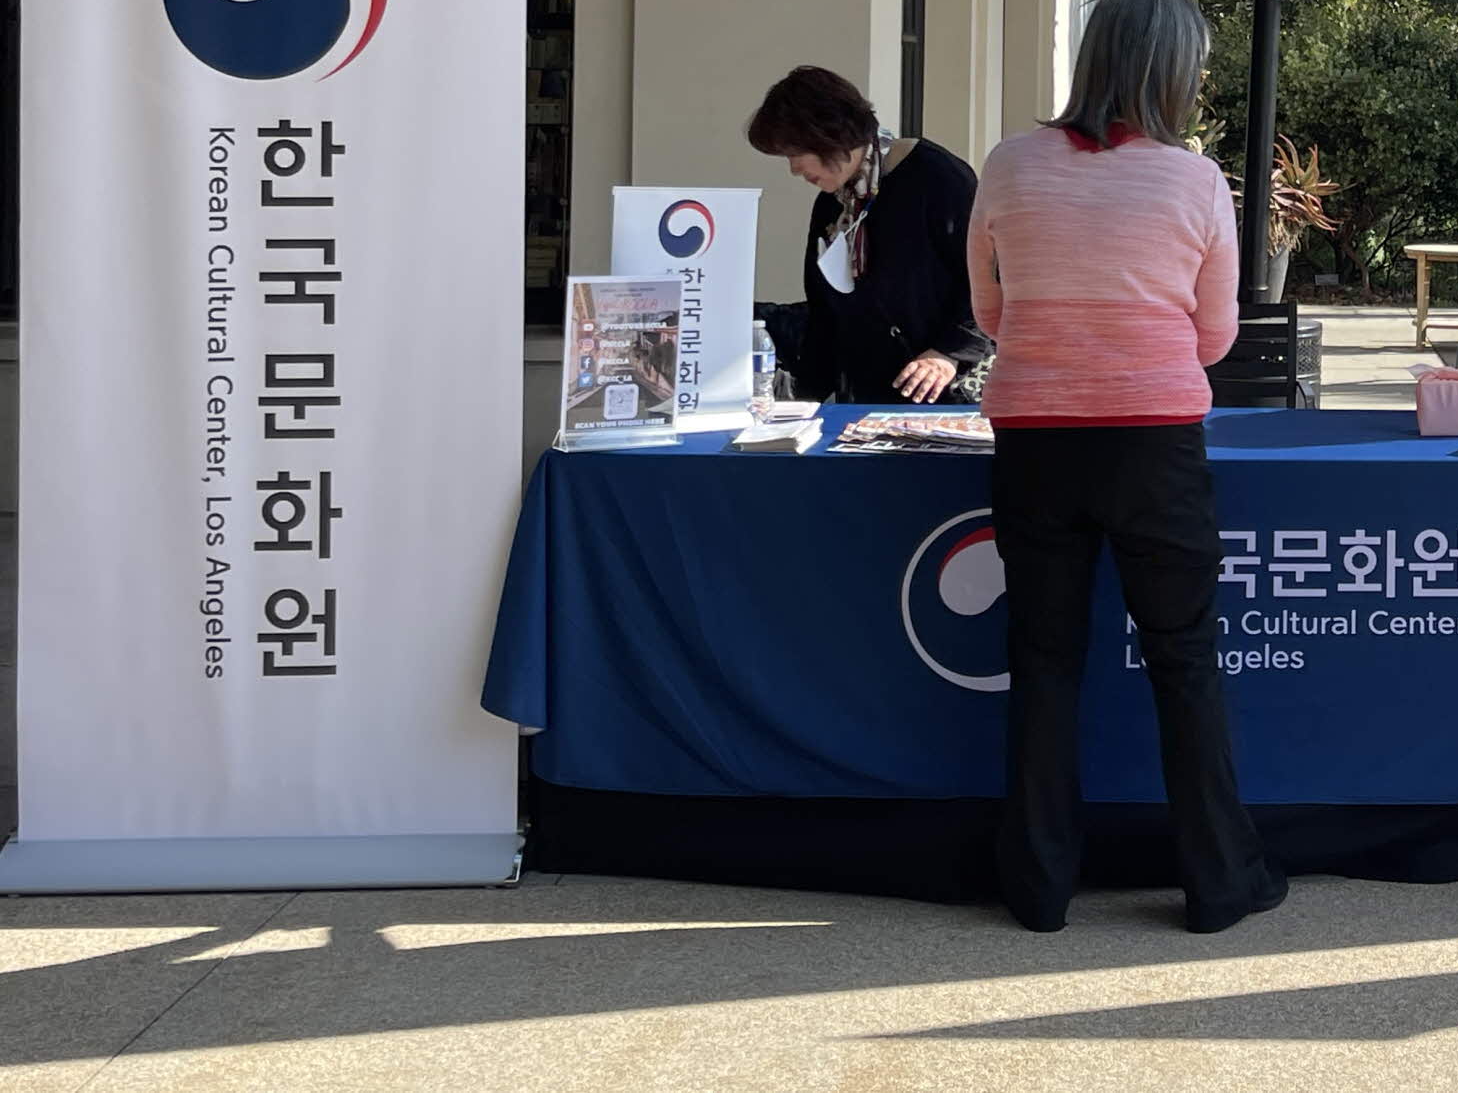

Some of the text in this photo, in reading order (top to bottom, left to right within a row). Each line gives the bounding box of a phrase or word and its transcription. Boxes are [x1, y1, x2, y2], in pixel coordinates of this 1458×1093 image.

[200, 127, 235, 679] Korean Cultural Center, Los Angeles
[254, 119, 345, 677] 한국문화원
[1241, 609, 1356, 635] Cultural
